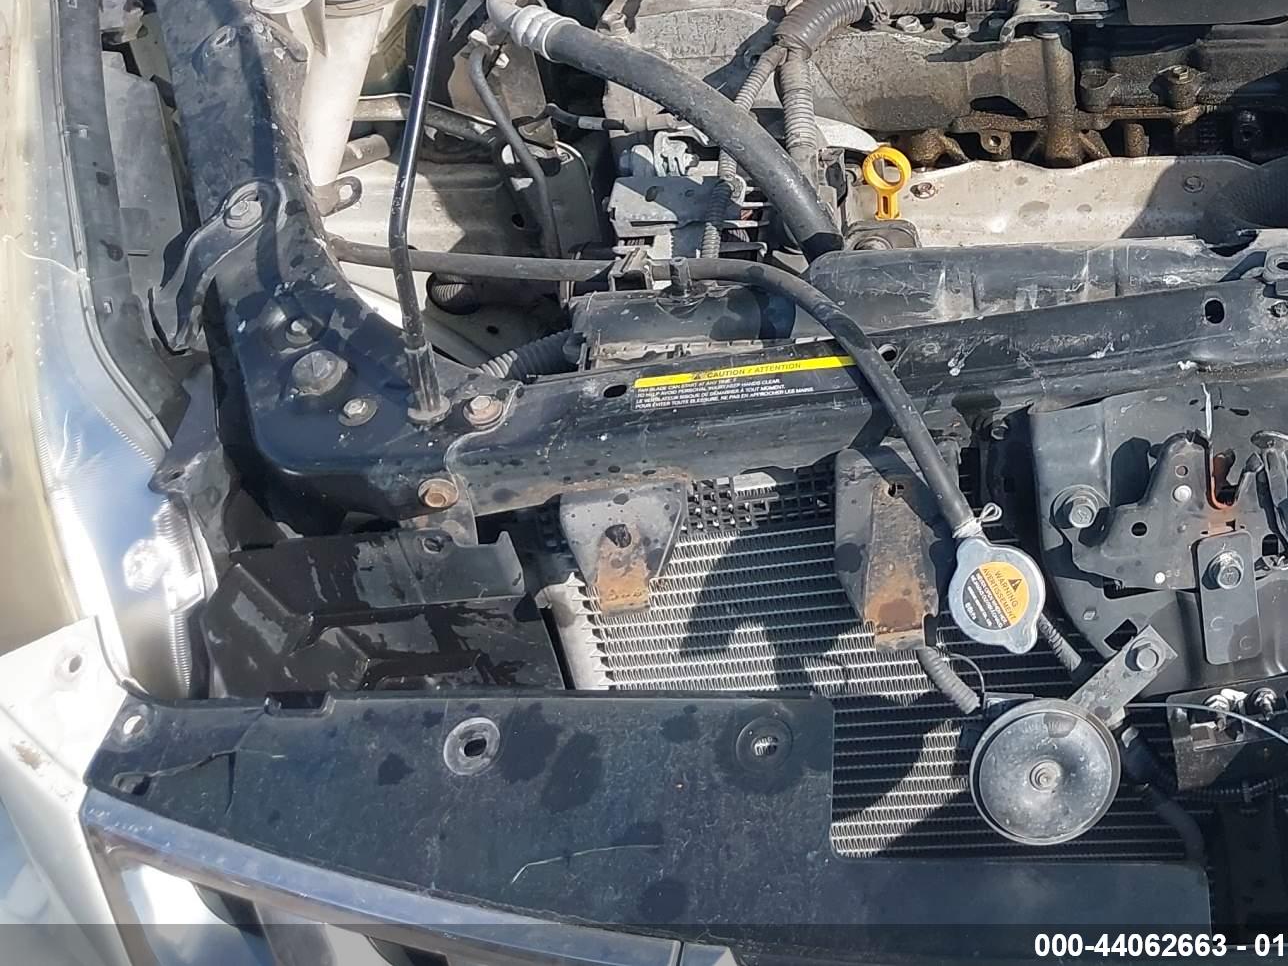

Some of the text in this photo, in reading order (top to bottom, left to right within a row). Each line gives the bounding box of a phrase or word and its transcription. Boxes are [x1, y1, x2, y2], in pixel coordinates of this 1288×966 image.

[707, 368, 744, 377] CAUTION
[754, 362, 800, 373] ATTENTION
[983, 568, 1016, 619] AVERTISSEMENT
[994, 570, 1019, 607] WARNING
